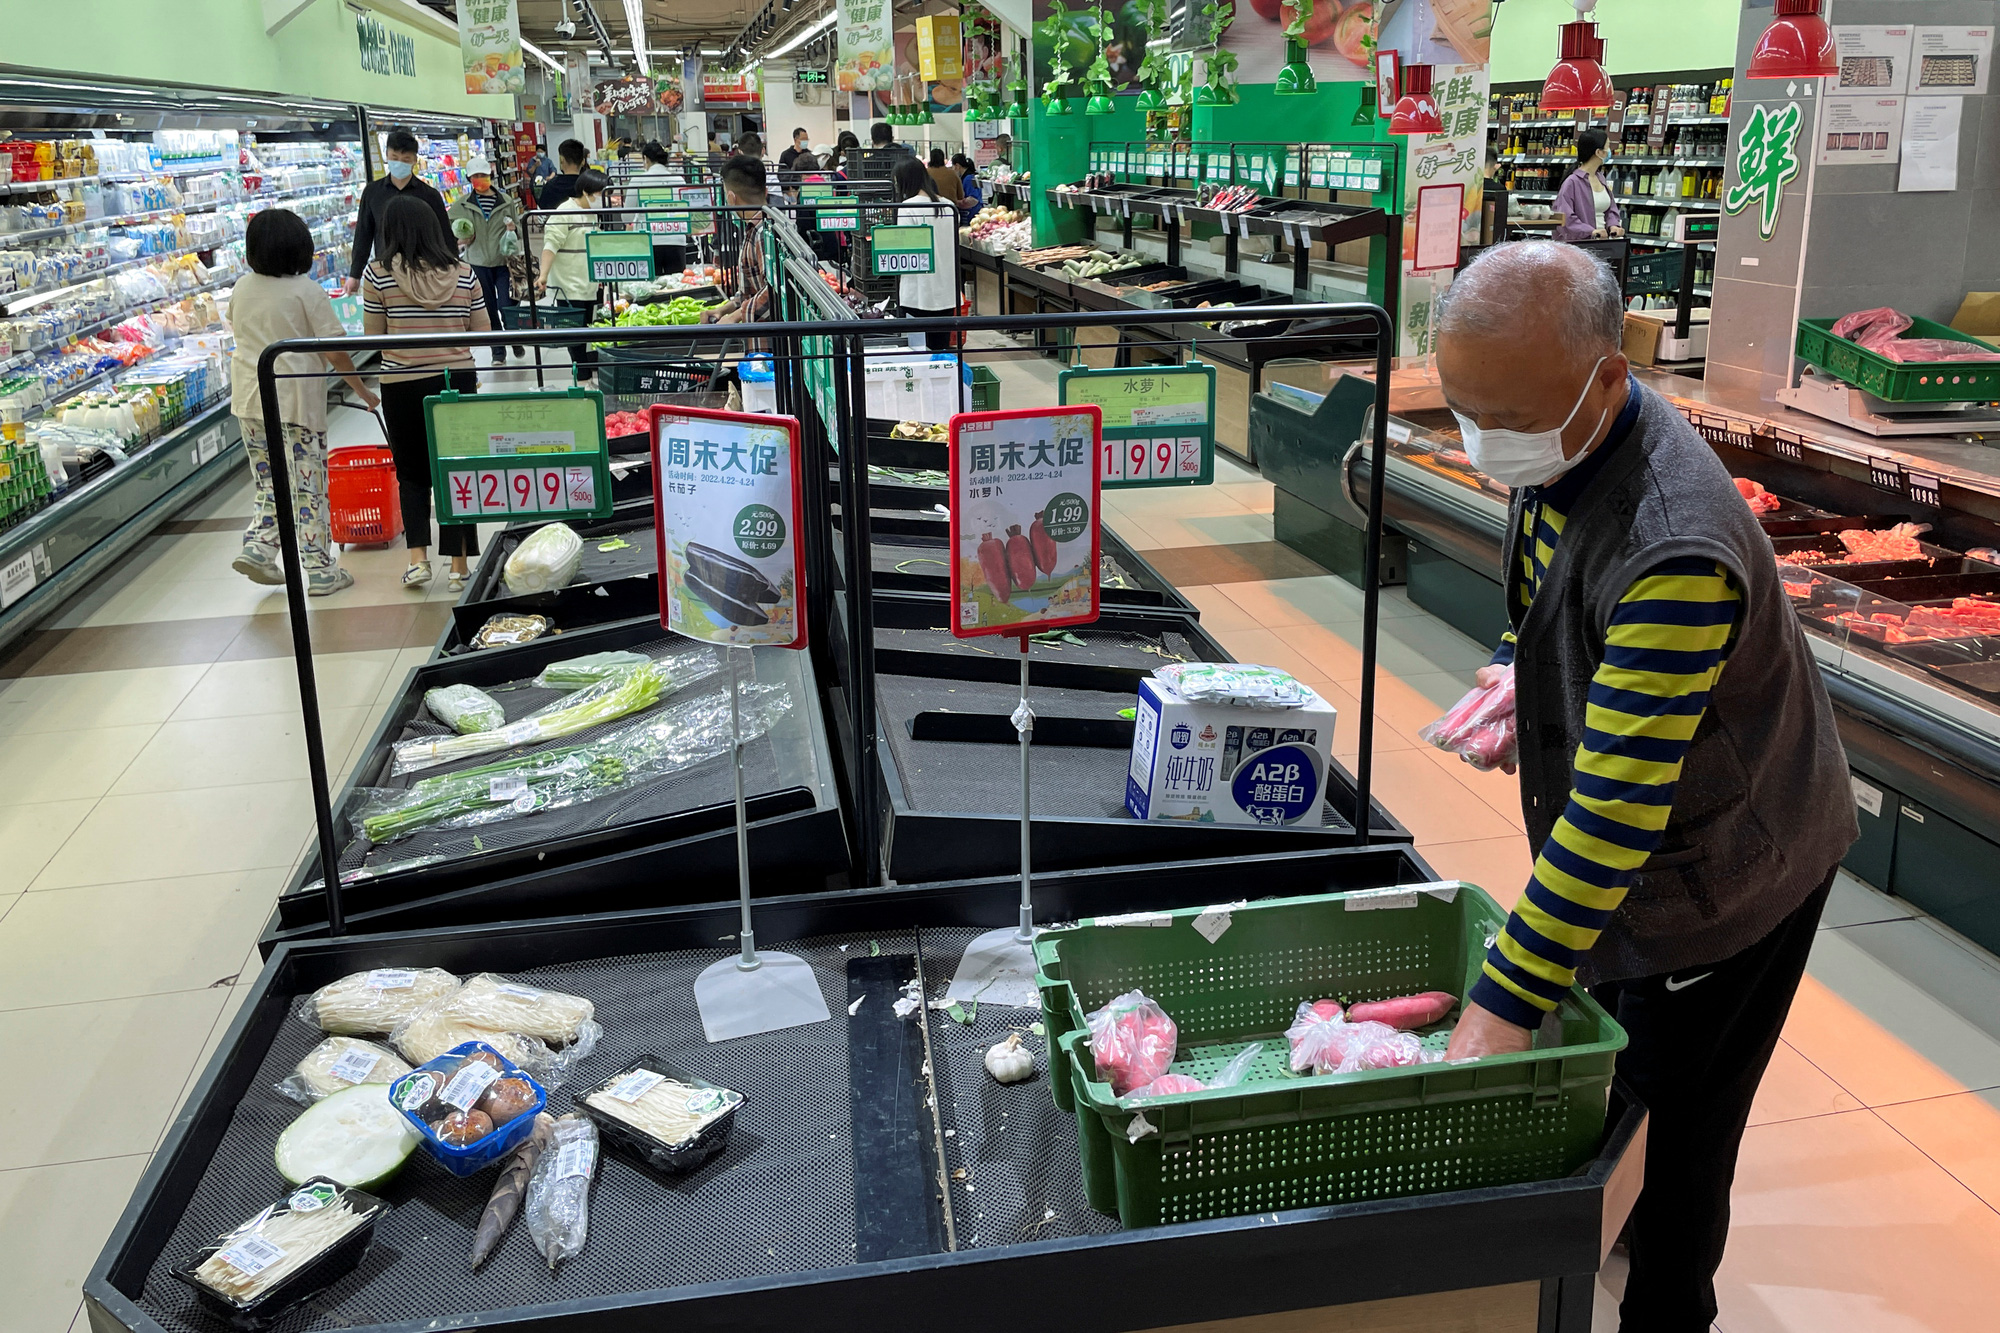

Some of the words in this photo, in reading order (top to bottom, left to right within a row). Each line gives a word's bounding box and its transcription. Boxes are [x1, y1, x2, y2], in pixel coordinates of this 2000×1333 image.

[1417, 147, 1477, 179] 每一天
[1123, 377, 1171, 395] 水萝卜
[498, 404, 553, 421] 长茄子
[668, 438, 778, 476] 周末大促
[969, 437, 1084, 475] 周末大促
[1104, 443, 1172, 475] 1.99
[700, 474, 755, 487] 2022.4.22-4.24
[1007, 470, 1063, 482] 2022.4.22-4.24
[668, 482, 697, 495] 长茄子
[969, 485, 1003, 499] 水萝卜
[1909, 487, 1934, 504] 1098
[1049, 506, 1083, 524] 1.99
[738, 518, 778, 537] 2.99
[1164, 755, 1215, 791] 纯牛奶
